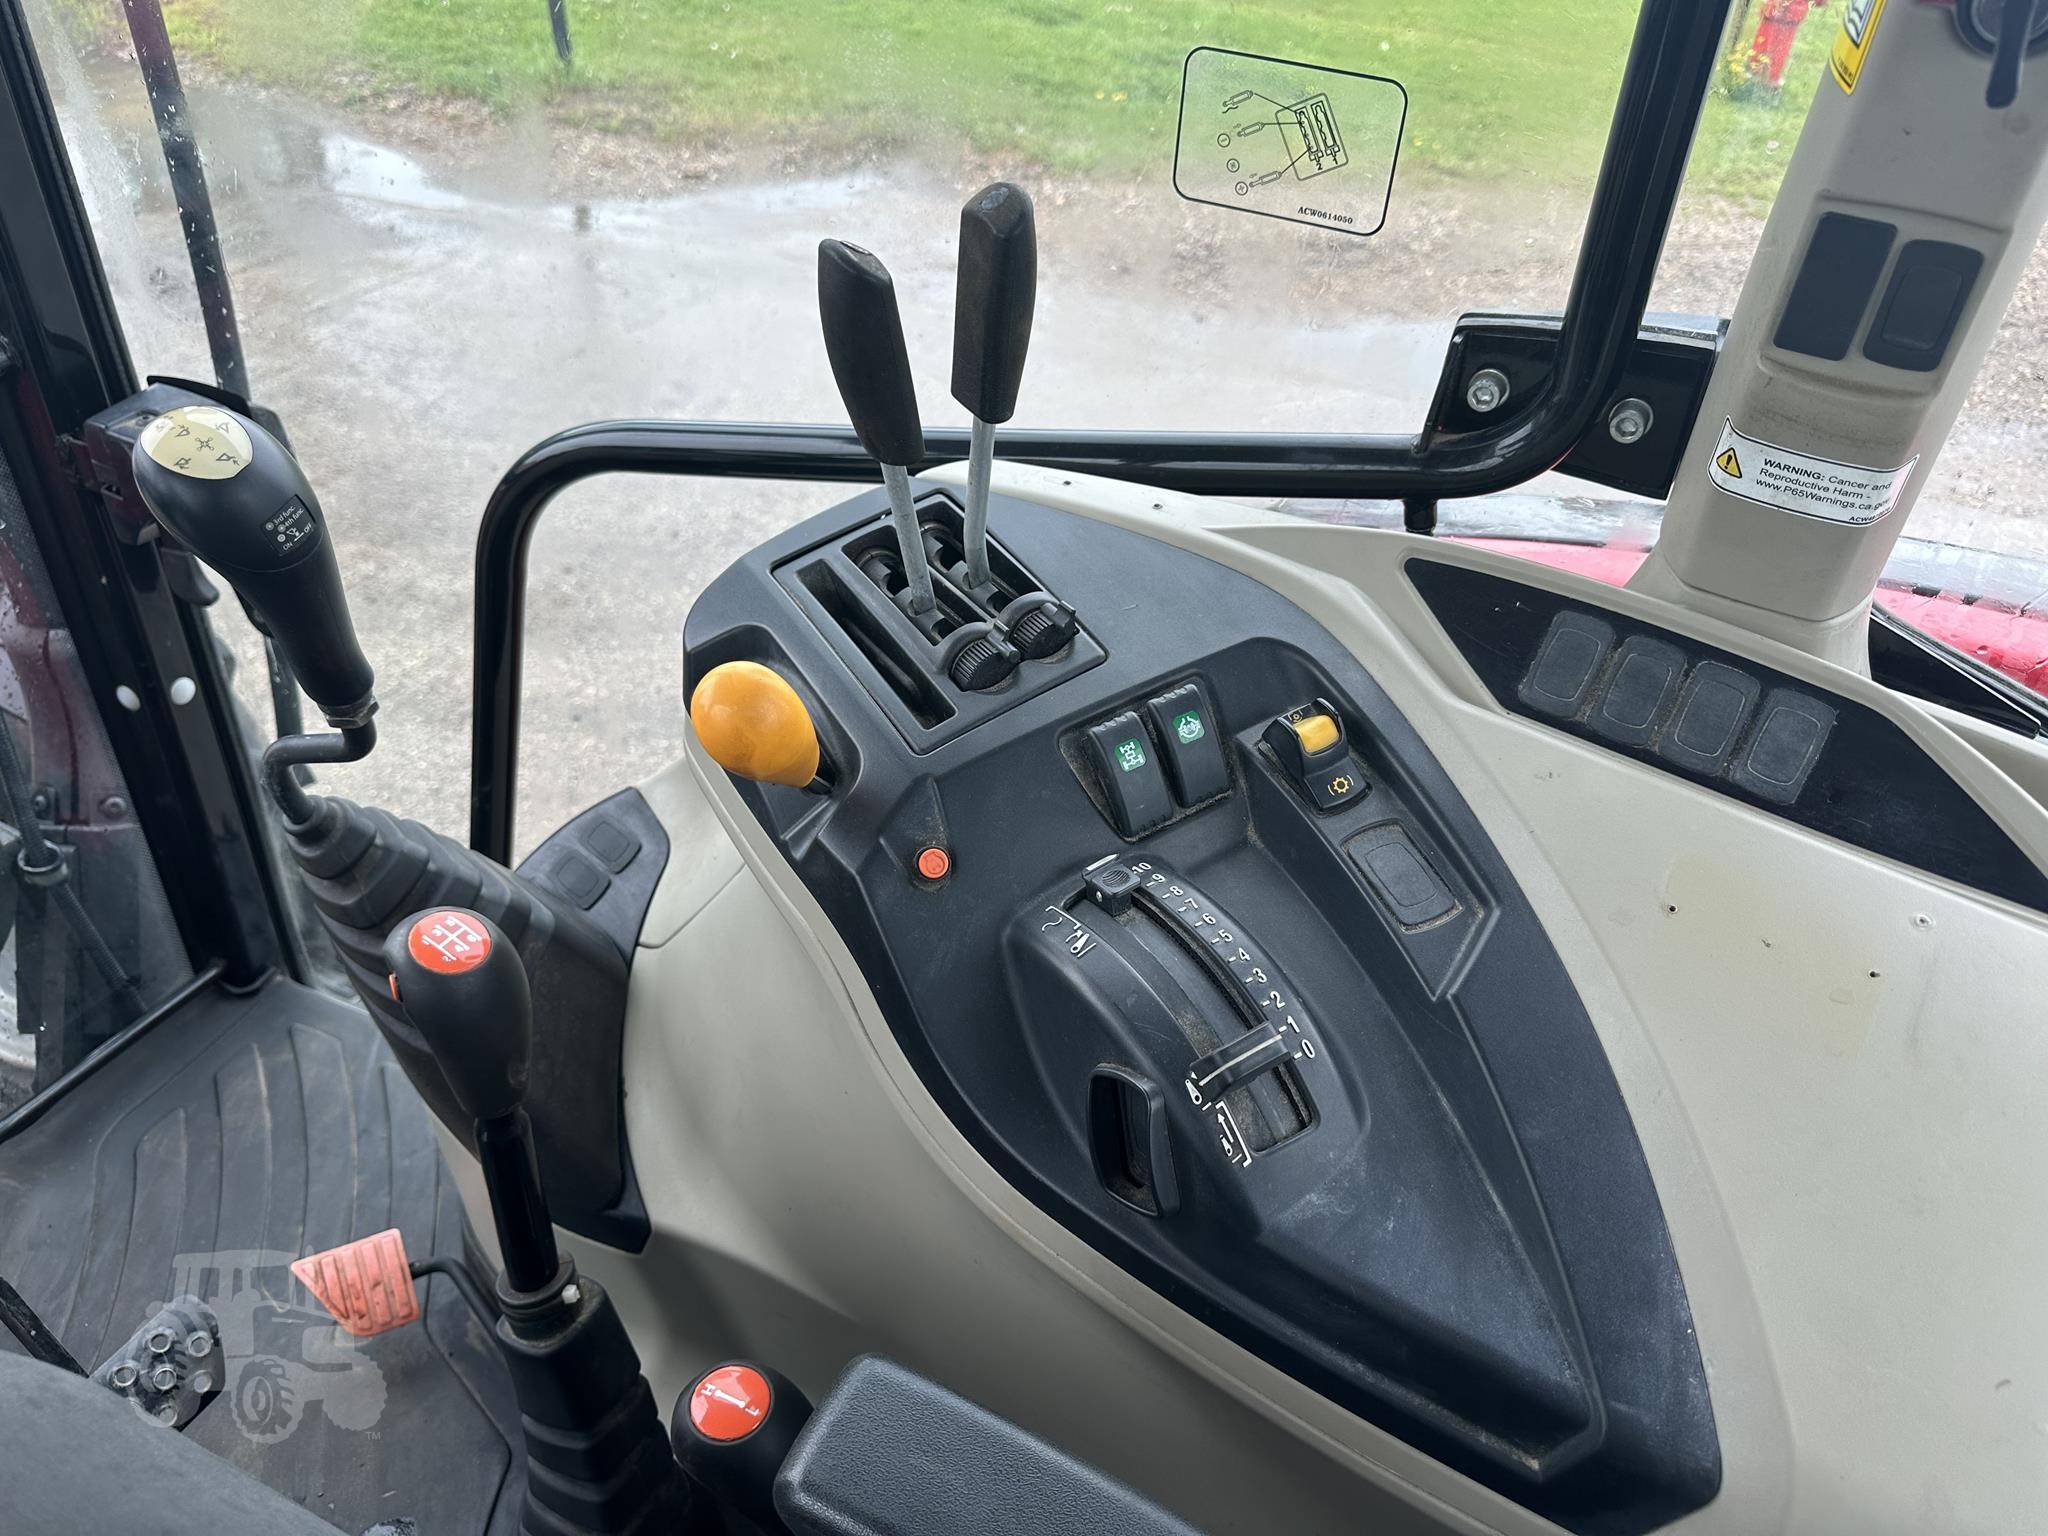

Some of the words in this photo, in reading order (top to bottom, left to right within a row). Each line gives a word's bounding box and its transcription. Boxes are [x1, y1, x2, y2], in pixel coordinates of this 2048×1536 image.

[1316, 162, 1323, 171] 2
[1298, 206, 1353, 224] ACW0614050
[1764, 458, 1825, 481] WARNING:
[1828, 475, 1870, 490] Cancer
[1871, 481, 1893, 491] and
[1760, 468, 1830, 493] Reproductive
[1833, 486, 1864, 500] Harm
[273, 514, 285, 526] 3rd
[282, 541, 293, 551] ON
[303, 522, 312, 534] OFF
[1131, 862, 1152, 874] 10
[1151, 873, 1166, 883] 9
[1169, 885, 1184, 896] 8
[1184, 898, 1198, 909] 7
[1202, 912, 1217, 925] 6
[1218, 929, 1233, 942] 5
[1239, 947, 1251, 961] 4
[1253, 968, 1267, 983] 3
[1270, 991, 1286, 1009] 2
[1287, 1015, 1300, 1033] 1
[1301, 1039, 1316, 1059] 0
[701, 1383, 716, 1397] H
[745, 1407, 760, 1417] L
